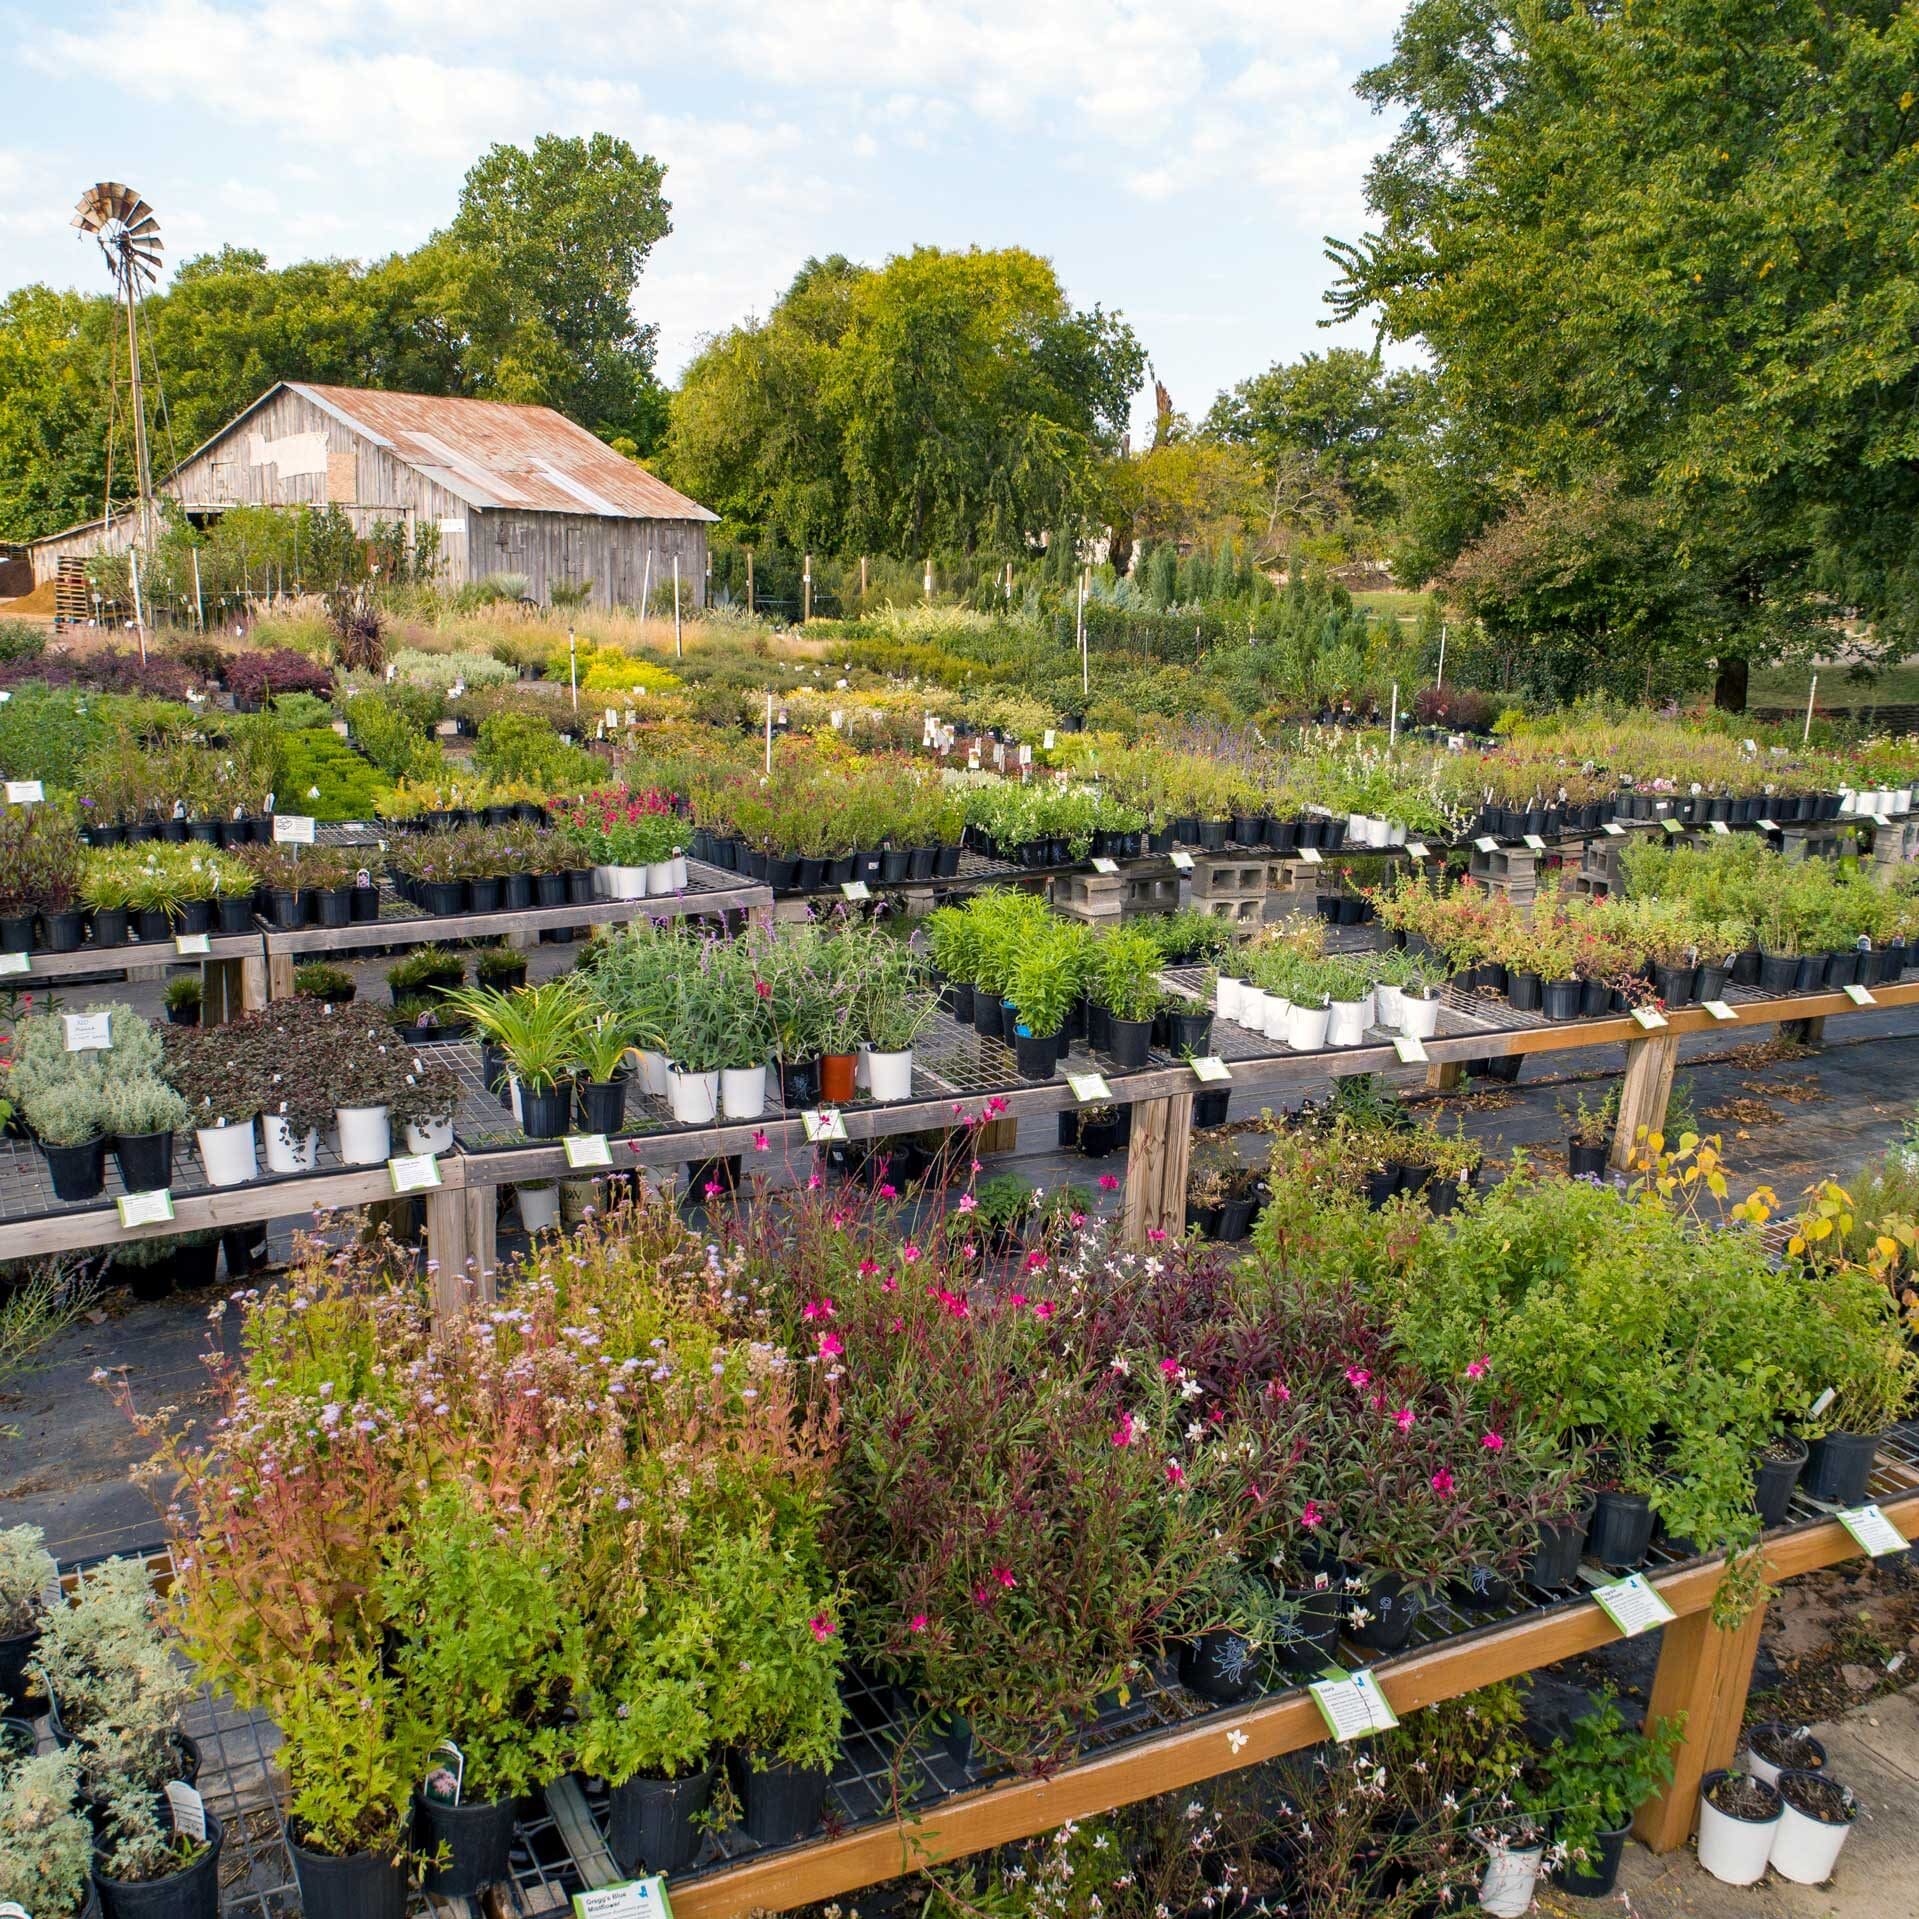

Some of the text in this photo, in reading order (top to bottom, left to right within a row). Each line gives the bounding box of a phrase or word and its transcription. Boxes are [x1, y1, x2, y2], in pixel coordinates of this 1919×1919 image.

[586, 1892, 627, 1905] Gregg's Blue
[587, 1902, 620, 1912] Mistflower
